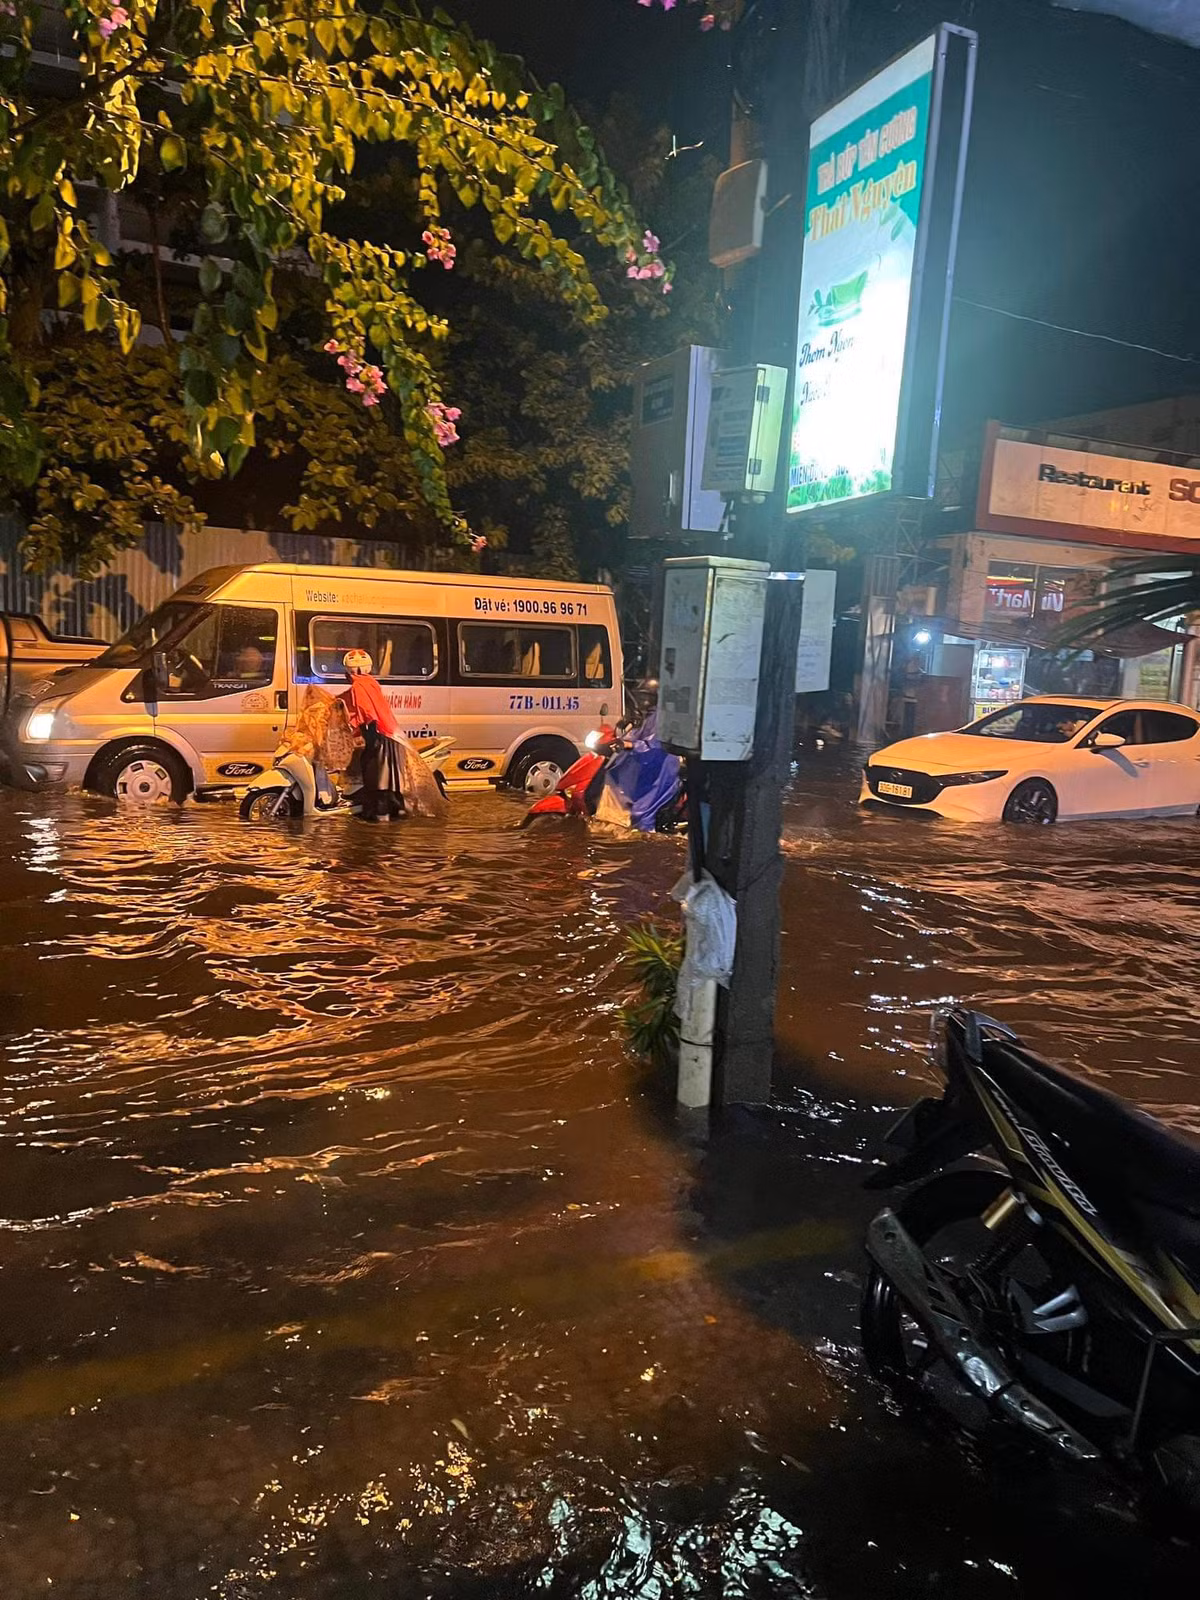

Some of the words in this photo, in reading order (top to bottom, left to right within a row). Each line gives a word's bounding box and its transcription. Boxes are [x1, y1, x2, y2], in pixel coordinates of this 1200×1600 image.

[1039, 463, 1151, 495] Restaurant
[305, 589, 339, 603] Website:
[474, 597, 492, 614] Đặt
[494, 598, 510, 612] vé:
[513, 599, 557, 614] 1900.96
[560, 602, 574, 615] 96
[577, 603, 588, 616] 71
[225, 763, 255, 775] Ford
[464, 759, 488, 771] Ford
